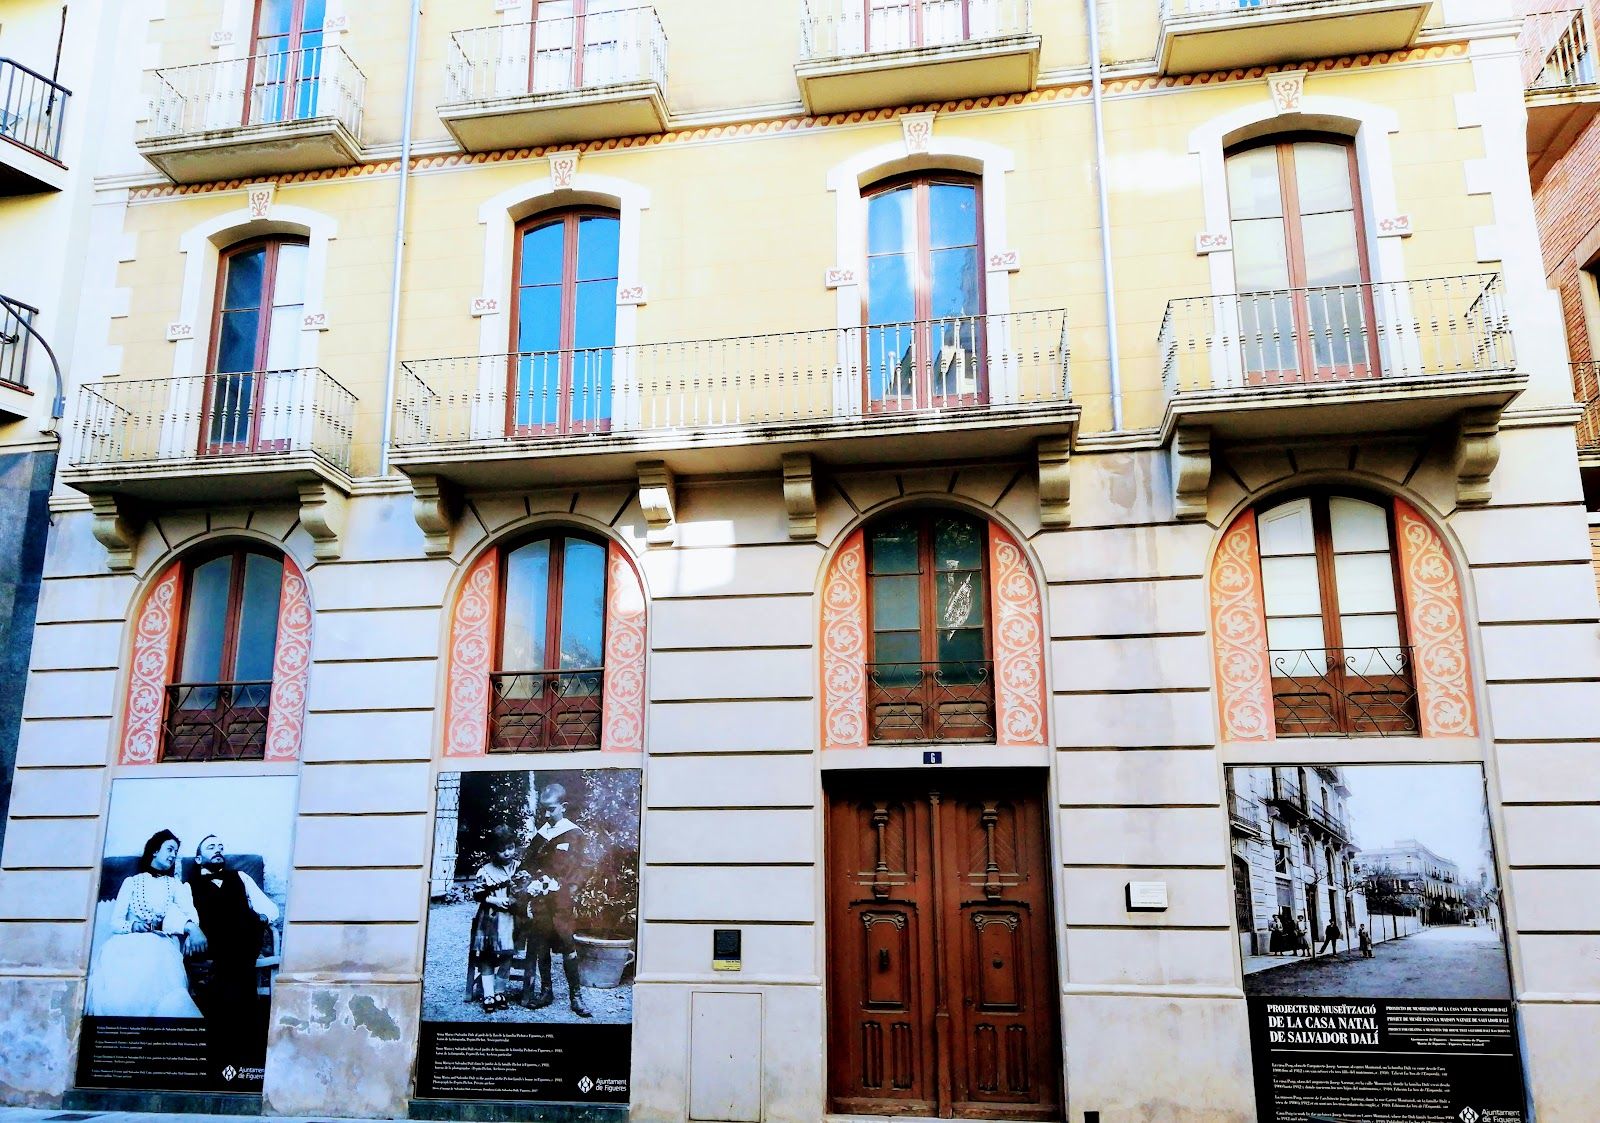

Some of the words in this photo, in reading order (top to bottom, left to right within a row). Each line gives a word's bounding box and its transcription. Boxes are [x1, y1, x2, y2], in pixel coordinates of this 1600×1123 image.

[930, 752, 936, 764] 6
[1266, 1004, 1309, 1014] PROJECTE
[1309, 1004, 1321, 1014] DE
[1268, 1016, 1285, 1028] DE
[1286, 1016, 1303, 1028] LA
[1304, 1016, 1336, 1029] CASA
[1338, 1017, 1378, 1030] NATAL
[1269, 1030, 1286, 1043] DE
[1288, 1031, 1348, 1044] SALVADOR
[1350, 1030, 1380, 1045] DALÍ
[596, 1078, 626, 1086] Ajuntament
